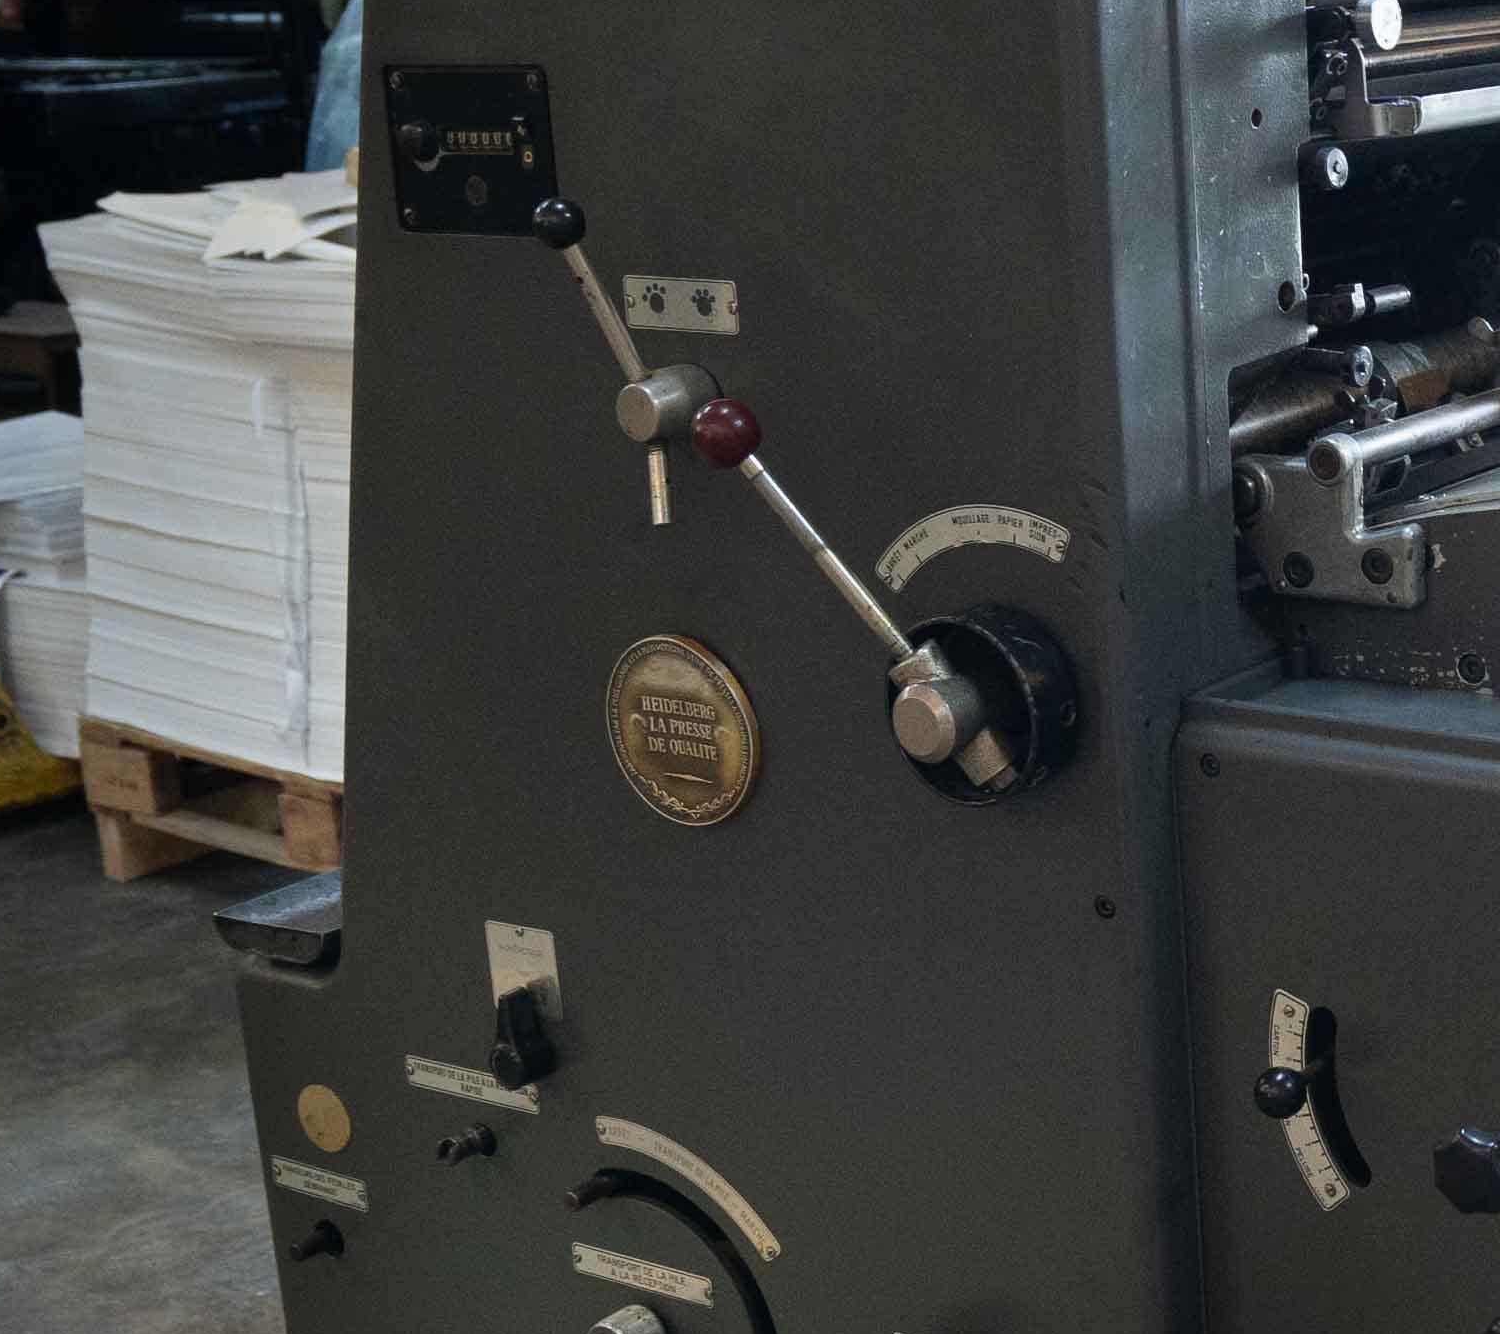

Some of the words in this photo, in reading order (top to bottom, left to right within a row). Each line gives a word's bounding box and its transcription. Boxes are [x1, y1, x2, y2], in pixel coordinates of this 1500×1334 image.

[951, 514, 991, 525] MOUILLAGE
[997, 514, 1024, 530] PAPIER
[642, 695, 716, 720] HEIDELBERG
[649, 716, 667, 733] LA
[669, 719, 713, 740] PRESSE
[647, 736, 667, 753] DE
